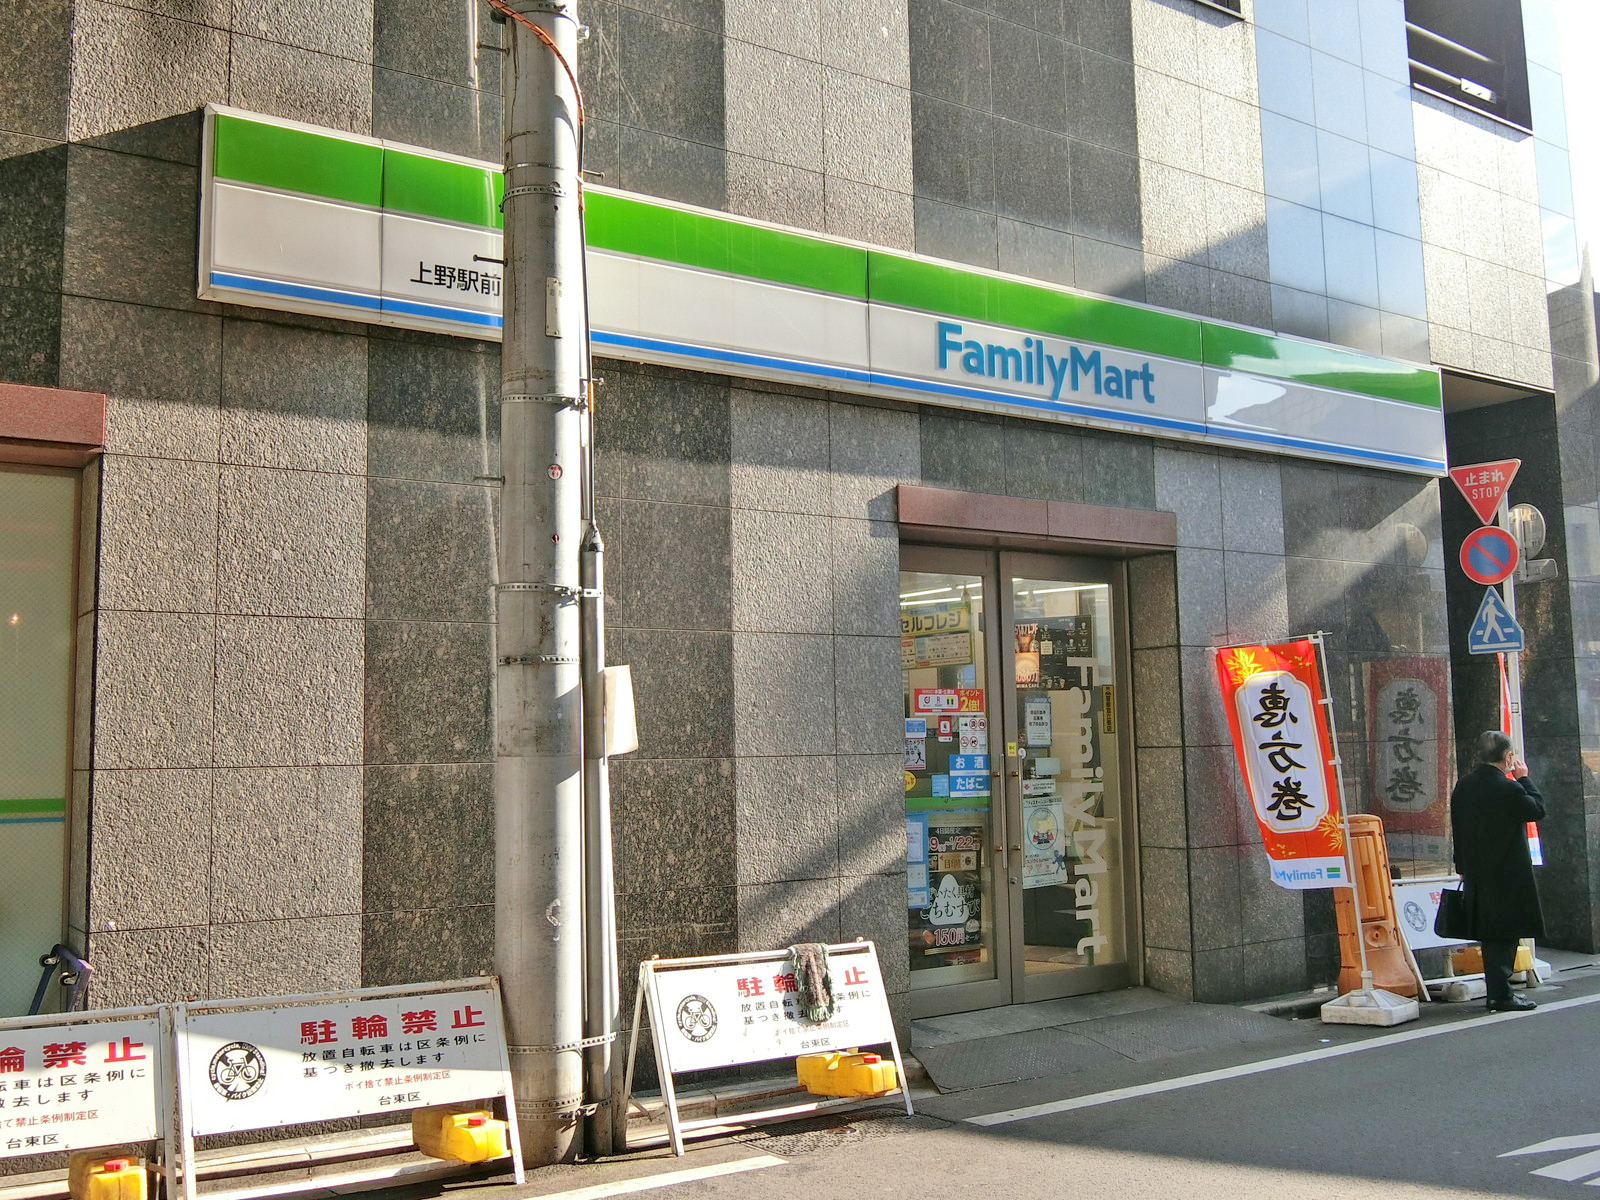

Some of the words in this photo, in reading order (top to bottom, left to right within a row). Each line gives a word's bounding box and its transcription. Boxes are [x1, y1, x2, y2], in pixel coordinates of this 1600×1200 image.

[410, 261, 501, 297] 上野駅前
[937, 321, 1155, 404] FamilyMart
[1464, 469, 1505, 487] 止まれ
[1472, 486, 1500, 500] STOP
[960, 697, 980, 711] 2倍!
[955, 756, 984, 769] お酒
[956, 777, 984, 790] たばこ
[1064, 656, 1108, 956] FamilyMart
[934, 928, 965, 946] 150円
[737, 967, 868, 998] 駐輪止
[300, 1005, 485, 1045] 駐輪禁止
[302, 1033, 486, 1063] 放置自転車は区条例に
[801, 1037, 831, 1049] 台東区
[303, 1052, 445, 1078] 基づき撤去します
[378, 1091, 421, 1106] 台東区
[0, 1109, 99, 1129] て禁止条例制定区
[6, 1133, 59, 1149] 台東区
